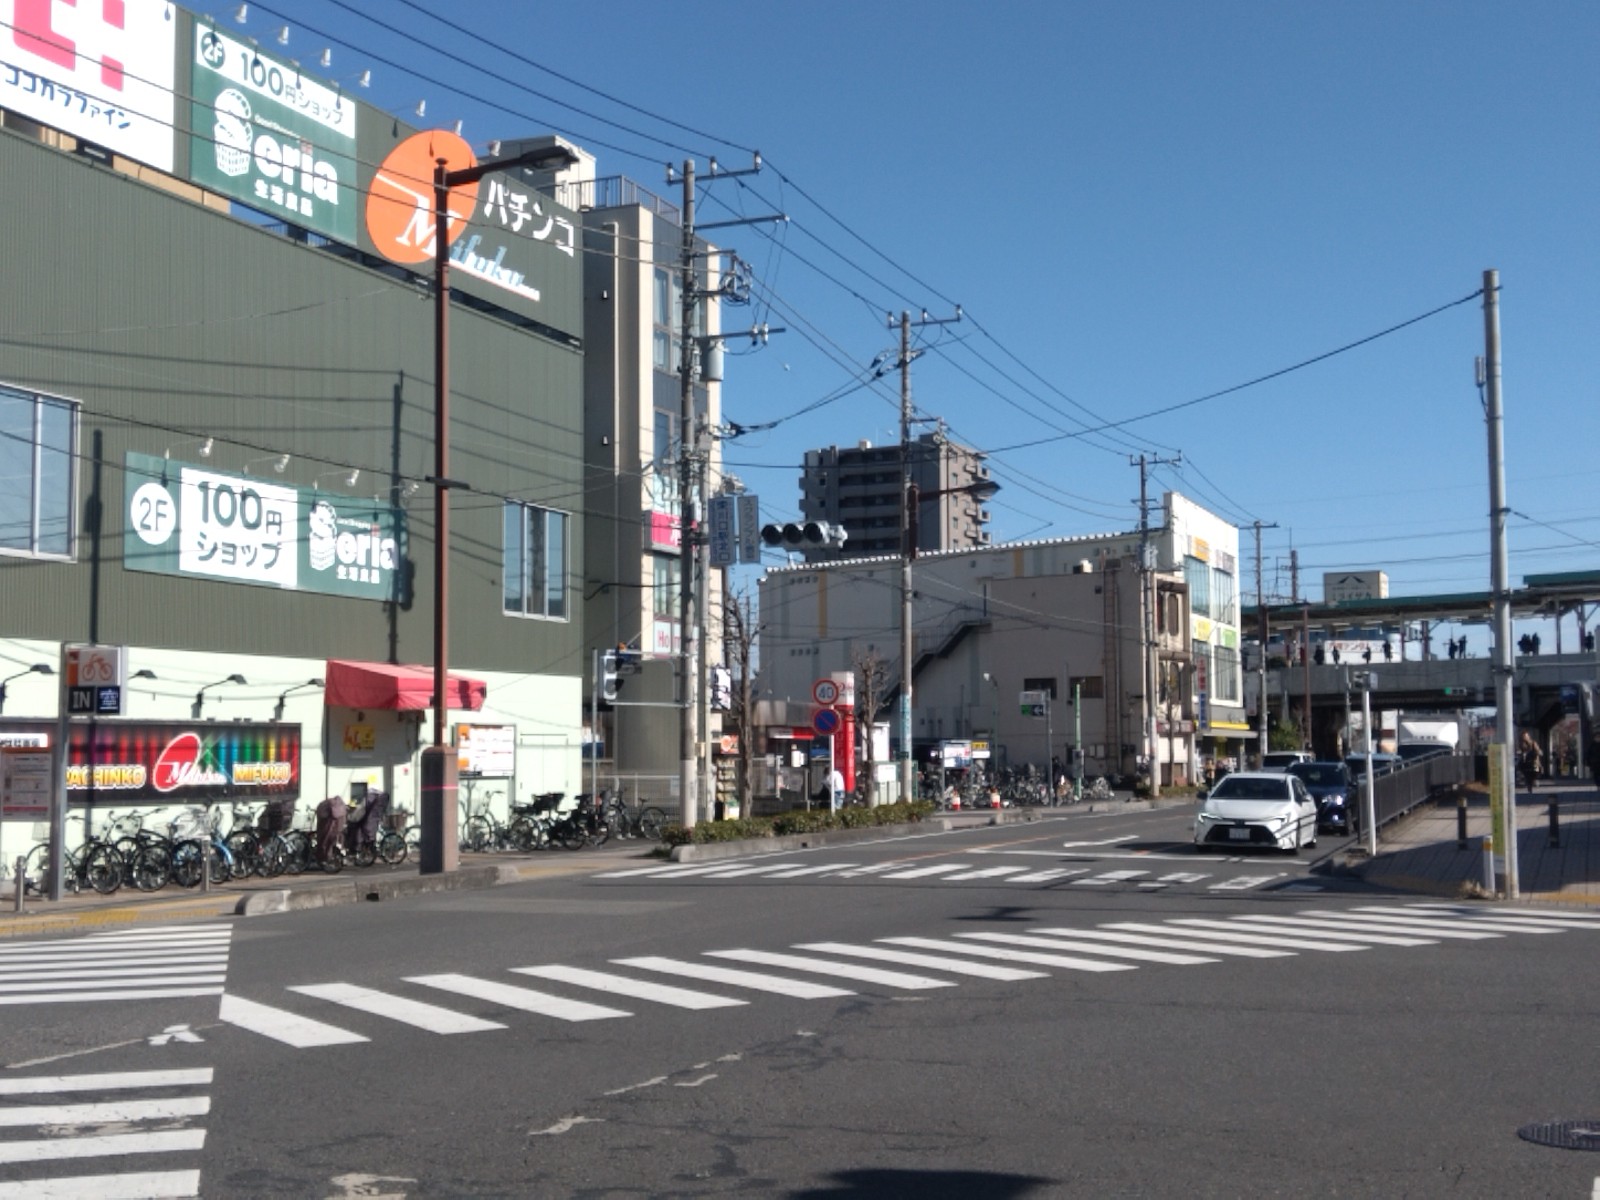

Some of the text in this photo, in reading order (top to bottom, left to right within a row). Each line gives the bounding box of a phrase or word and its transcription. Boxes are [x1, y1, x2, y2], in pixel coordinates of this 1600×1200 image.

[5, 64, 131, 129] ココカラファイン
[241, 52, 343, 124] 100円ショップ
[484, 180, 574, 258] パチンコ
[139, 497, 168, 532] 2F
[198, 481, 282, 536] 100円
[198, 532, 282, 570] ショップ
[73, 690, 91, 710] IN
[818, 685, 834, 699] 40
[233, 763, 291, 785] MIFUKU
